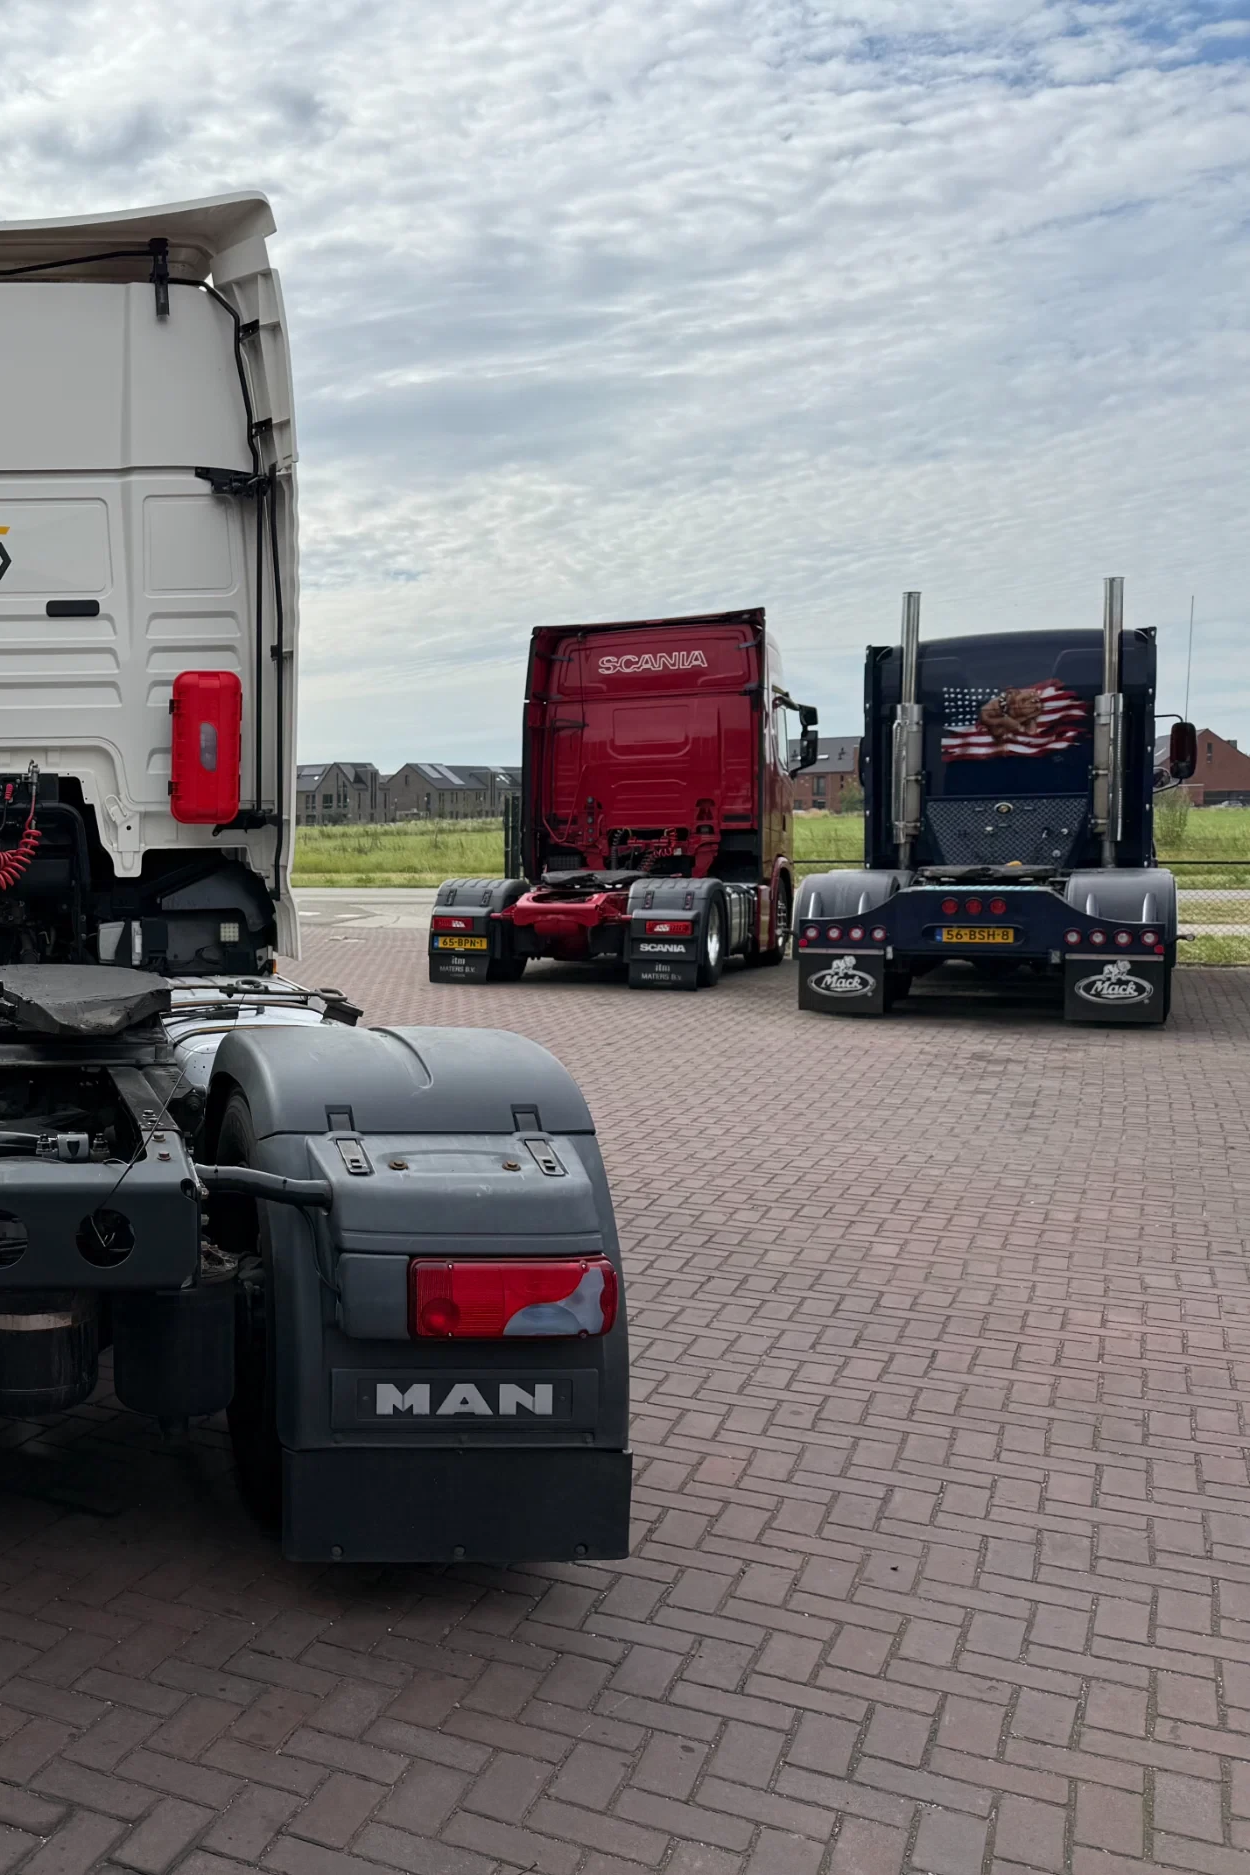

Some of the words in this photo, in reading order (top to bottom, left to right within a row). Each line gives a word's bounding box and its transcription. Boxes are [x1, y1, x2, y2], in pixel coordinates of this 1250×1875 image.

[598, 650, 708, 675] SCANIA
[442, 937, 483, 947] 65-BPN-1
[946, 929, 1009, 941] 56-BSH-8
[639, 943, 686, 953] SCANIA
[820, 975, 863, 989] Mack
[1089, 981, 1139, 996] Mack
[376, 1383, 553, 1416] MAN
